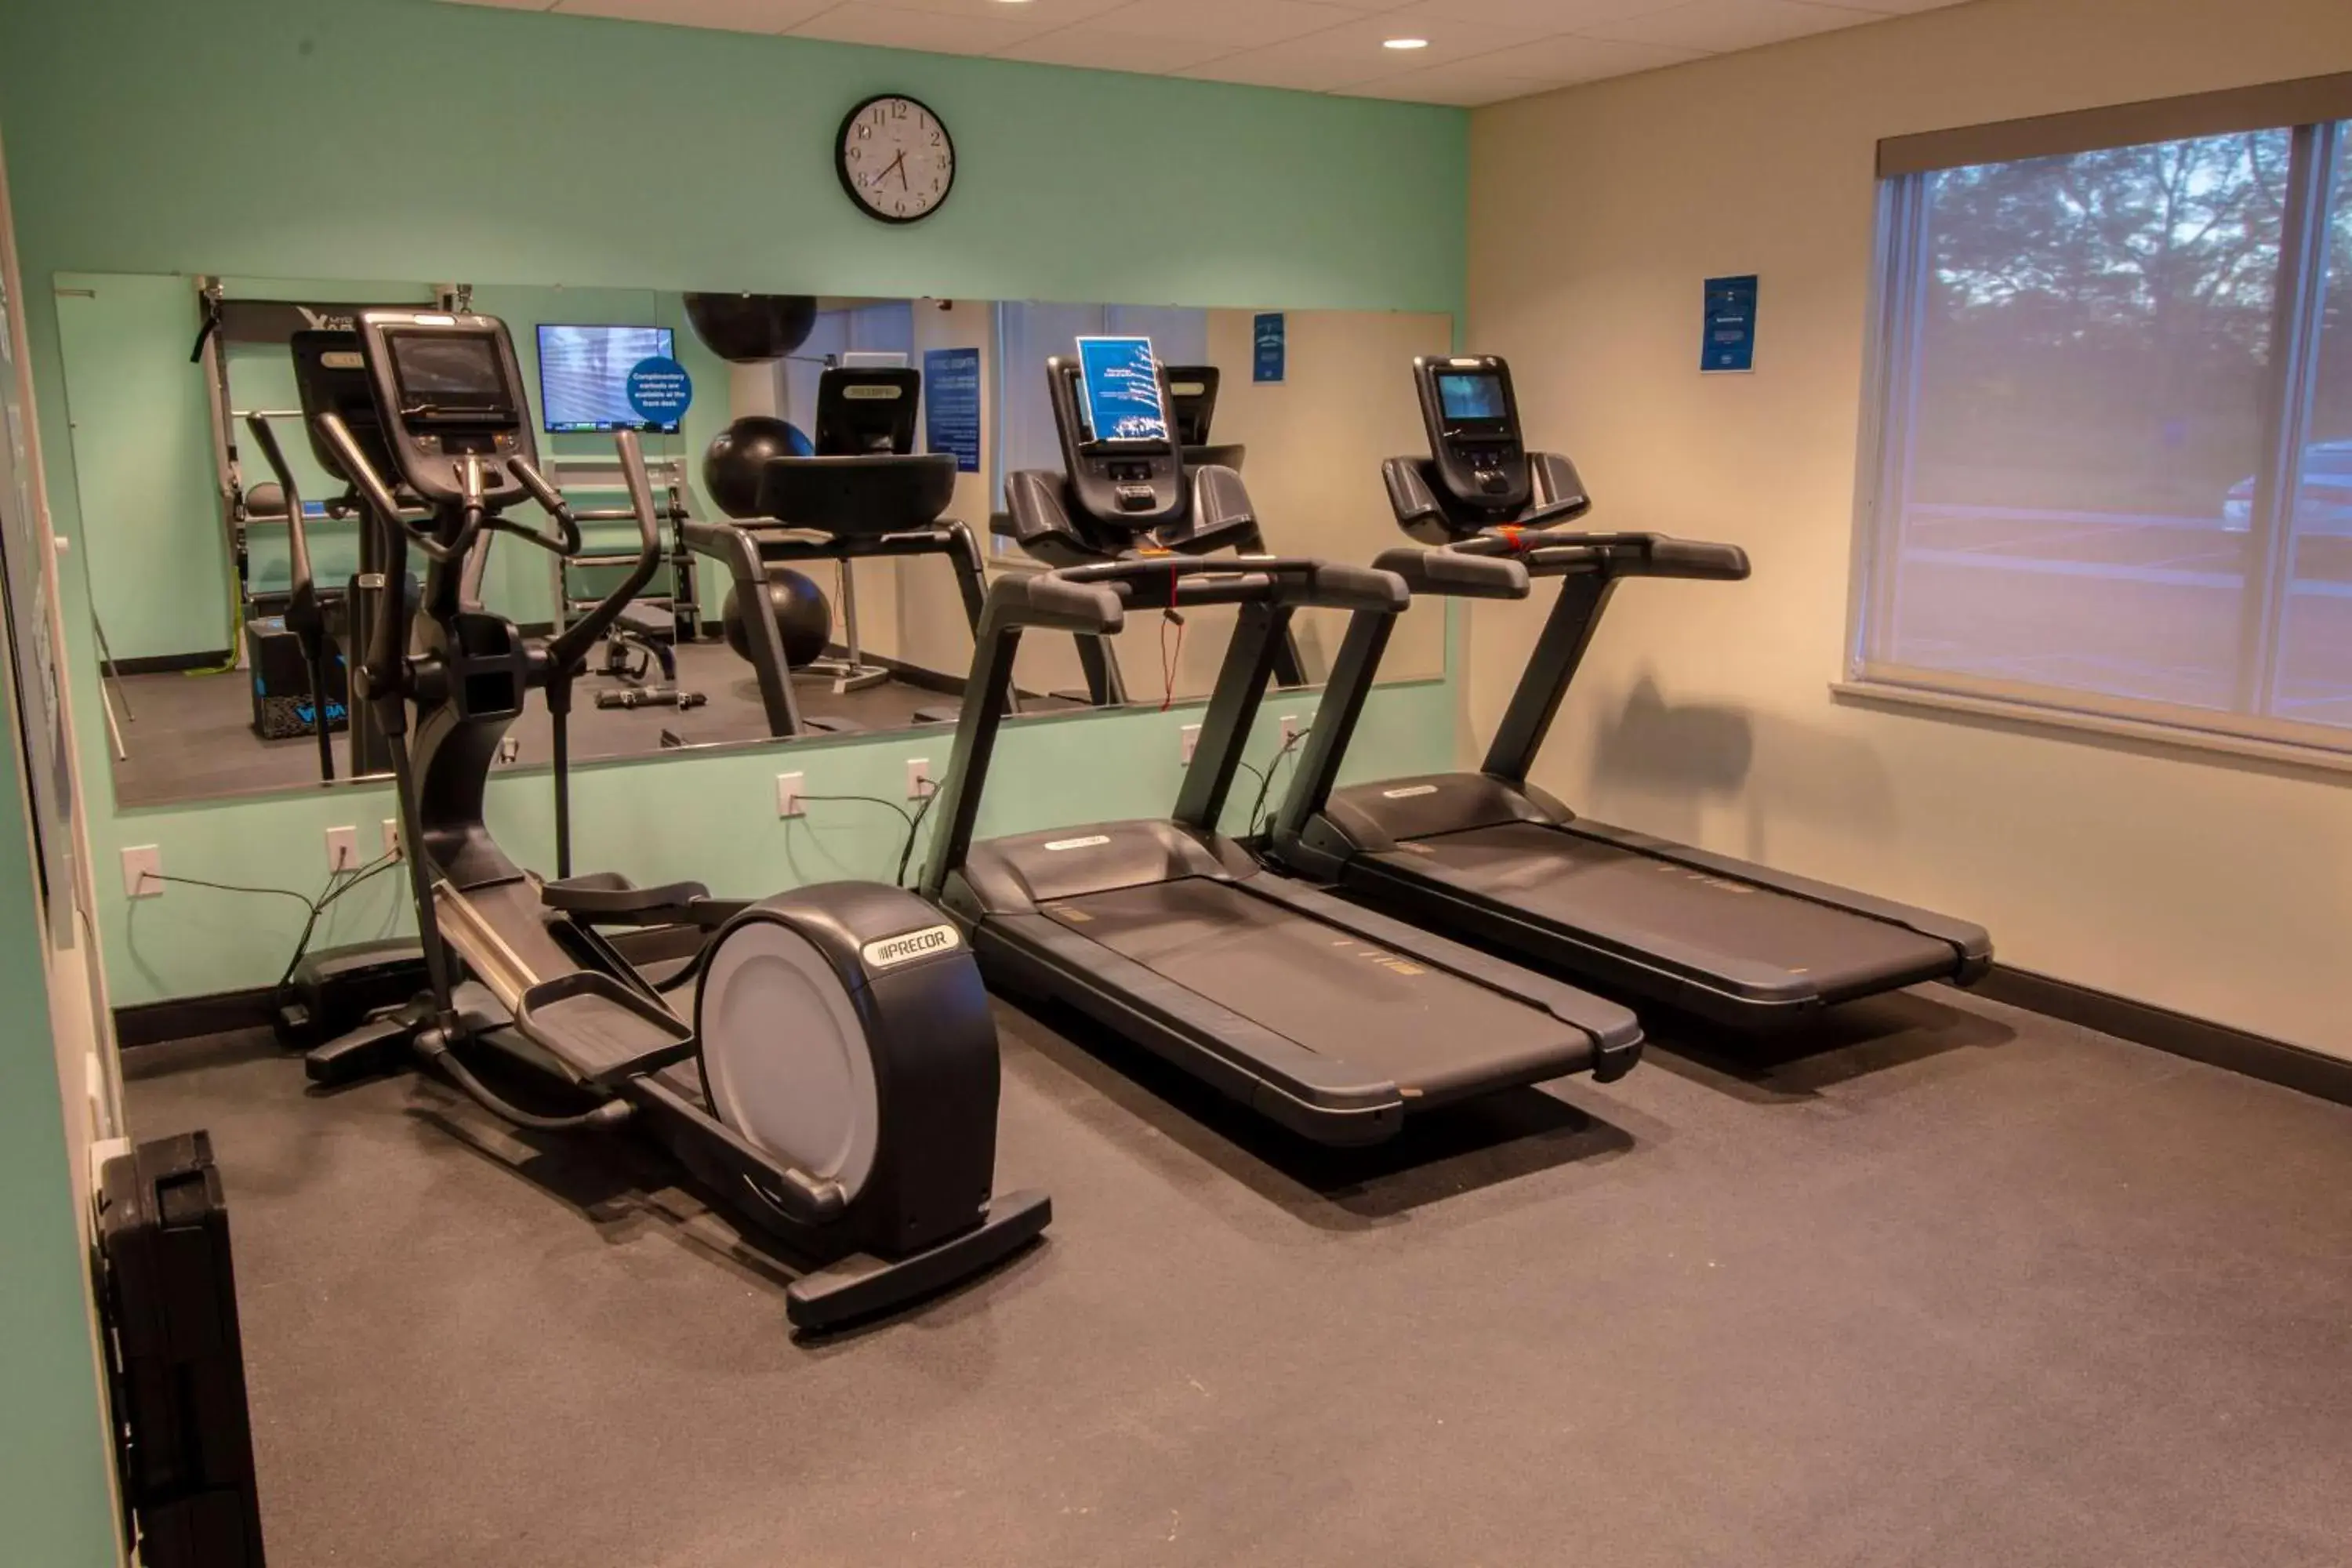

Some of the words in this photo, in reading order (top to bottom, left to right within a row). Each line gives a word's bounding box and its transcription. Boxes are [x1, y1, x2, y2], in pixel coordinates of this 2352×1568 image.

[873, 107, 885, 128] 11
[891, 102, 907, 120] 12
[920, 112, 924, 130] 1
[857, 122, 872, 141] 10
[930, 131, 941, 147] 2
[850, 146, 862, 162] 9
[937, 155, 946, 170] 3
[857, 171, 869, 187] 8
[931, 177, 939, 193] 4
[873, 190, 884, 207] 7
[895, 199, 906, 213] 6
[916, 192, 927, 209] 5
[887, 931, 947, 958] PRECOR
